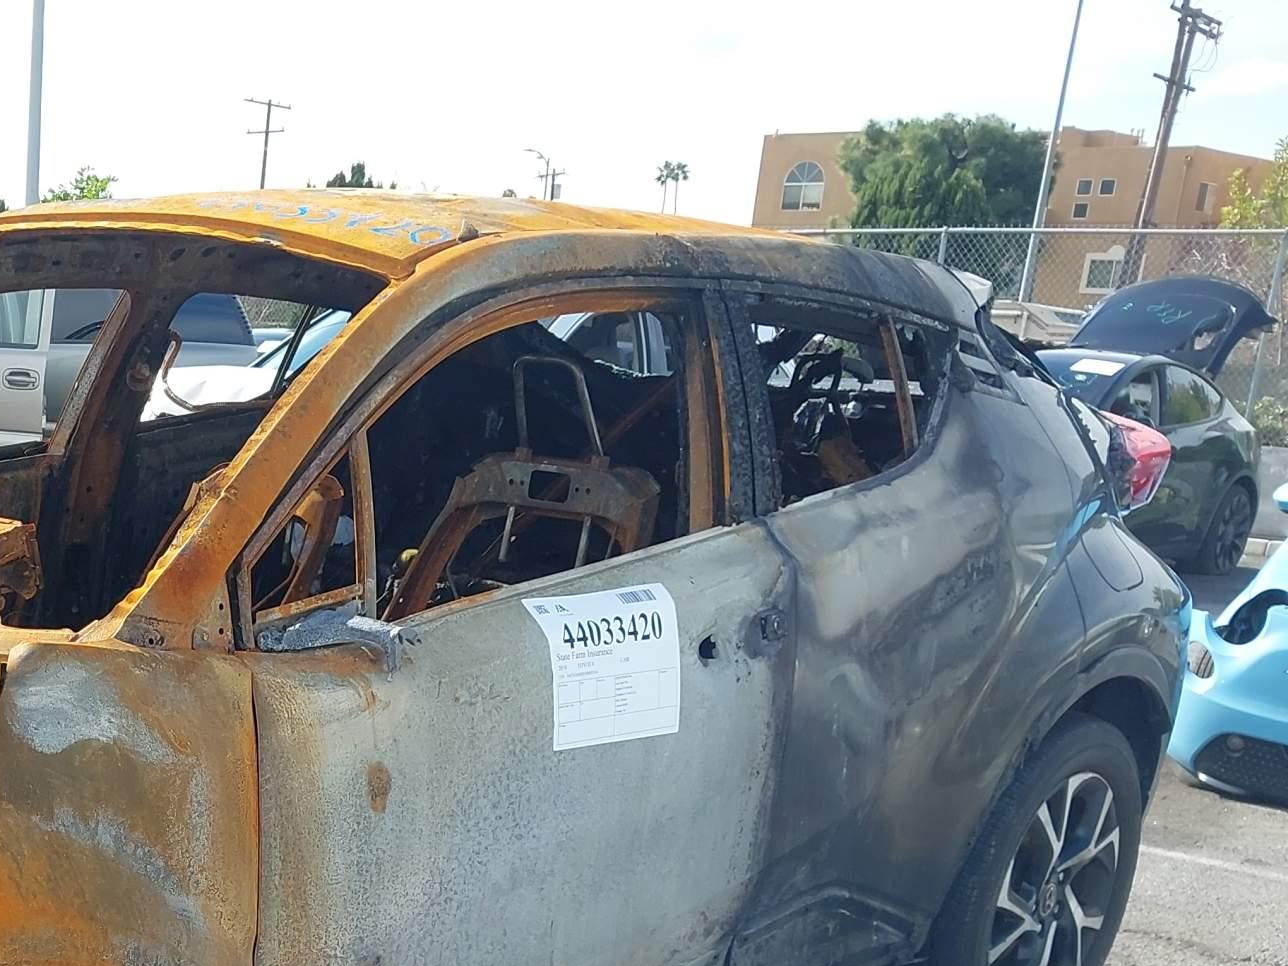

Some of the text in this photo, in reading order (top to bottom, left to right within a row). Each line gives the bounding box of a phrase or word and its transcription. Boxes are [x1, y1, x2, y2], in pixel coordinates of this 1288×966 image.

[563, 611, 663, 649] 44033420
[571, 650, 586, 660] Farm
[587, 648, 614, 658] Insurance
